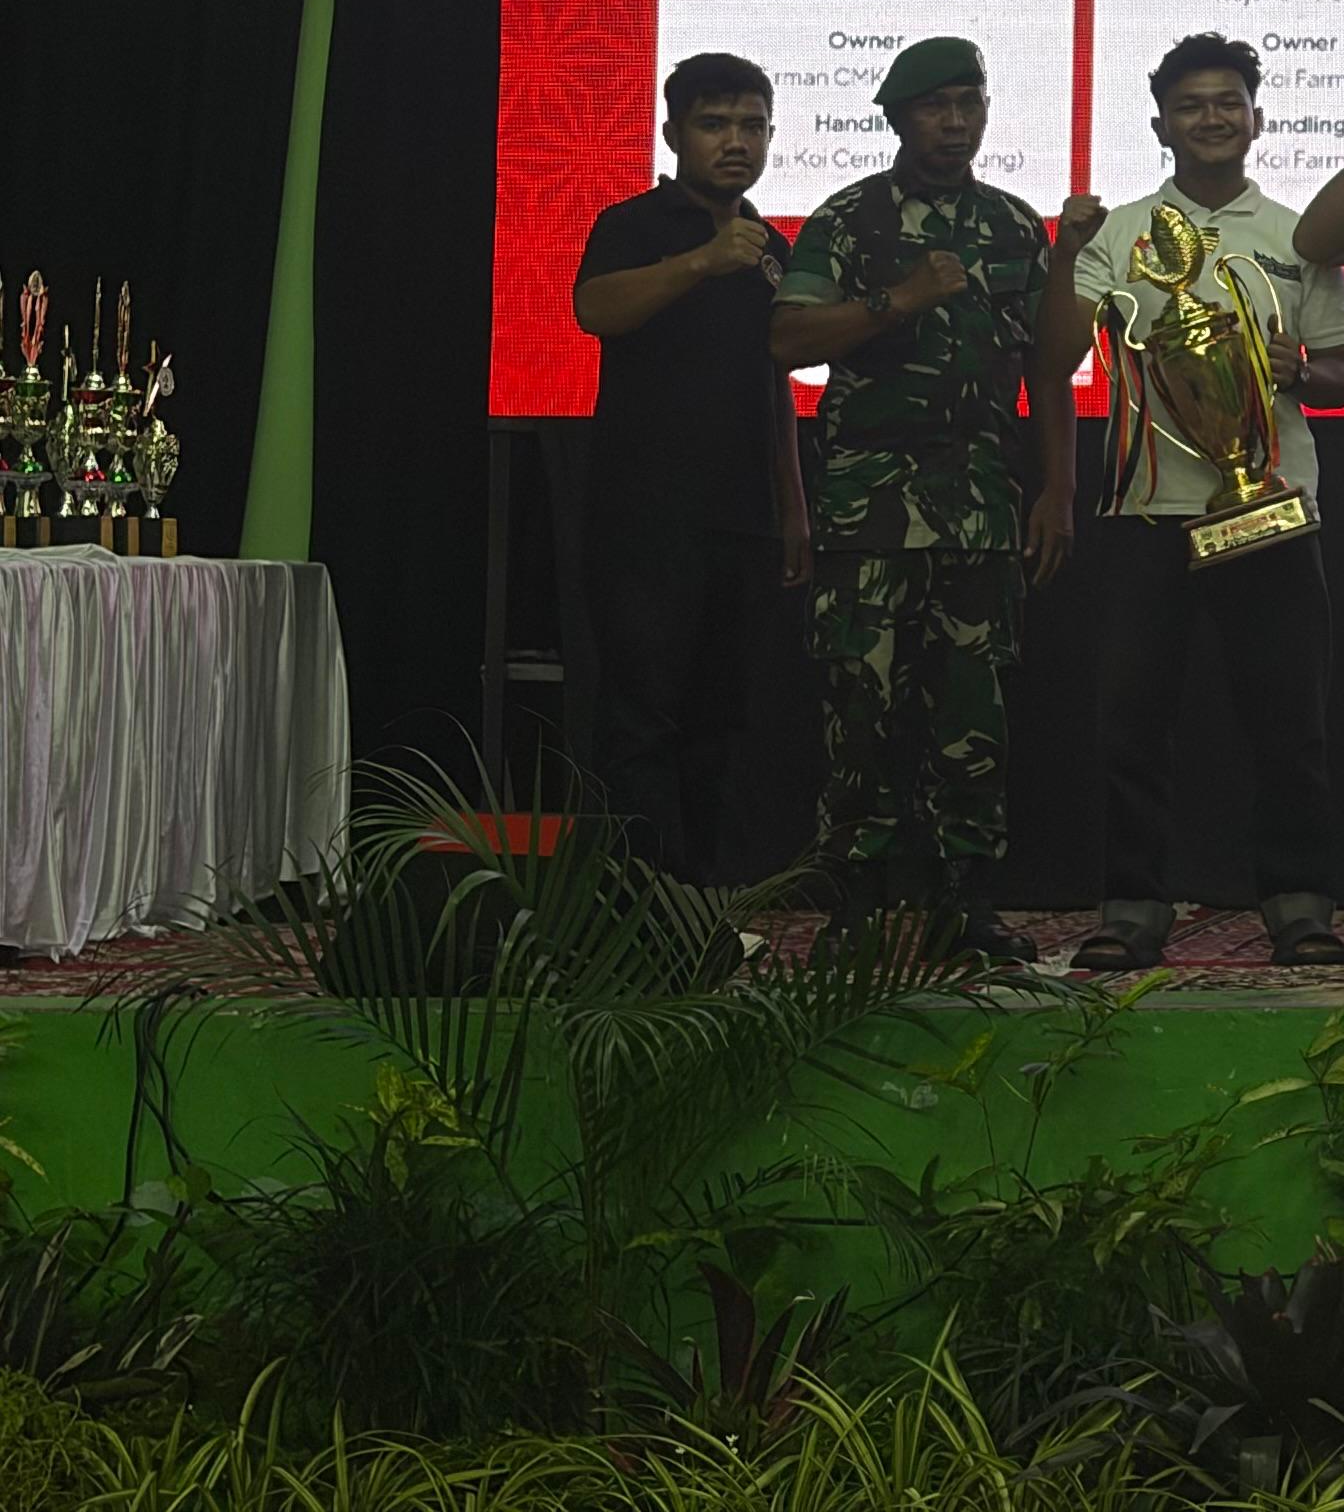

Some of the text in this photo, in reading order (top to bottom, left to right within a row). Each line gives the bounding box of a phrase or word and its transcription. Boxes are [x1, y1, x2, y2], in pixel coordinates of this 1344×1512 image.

[829, 31, 905, 49] Owner
[1262, 33, 1337, 51] Owner
[794, 148, 827, 168] Koi
[832, 148, 893, 169] Centr
